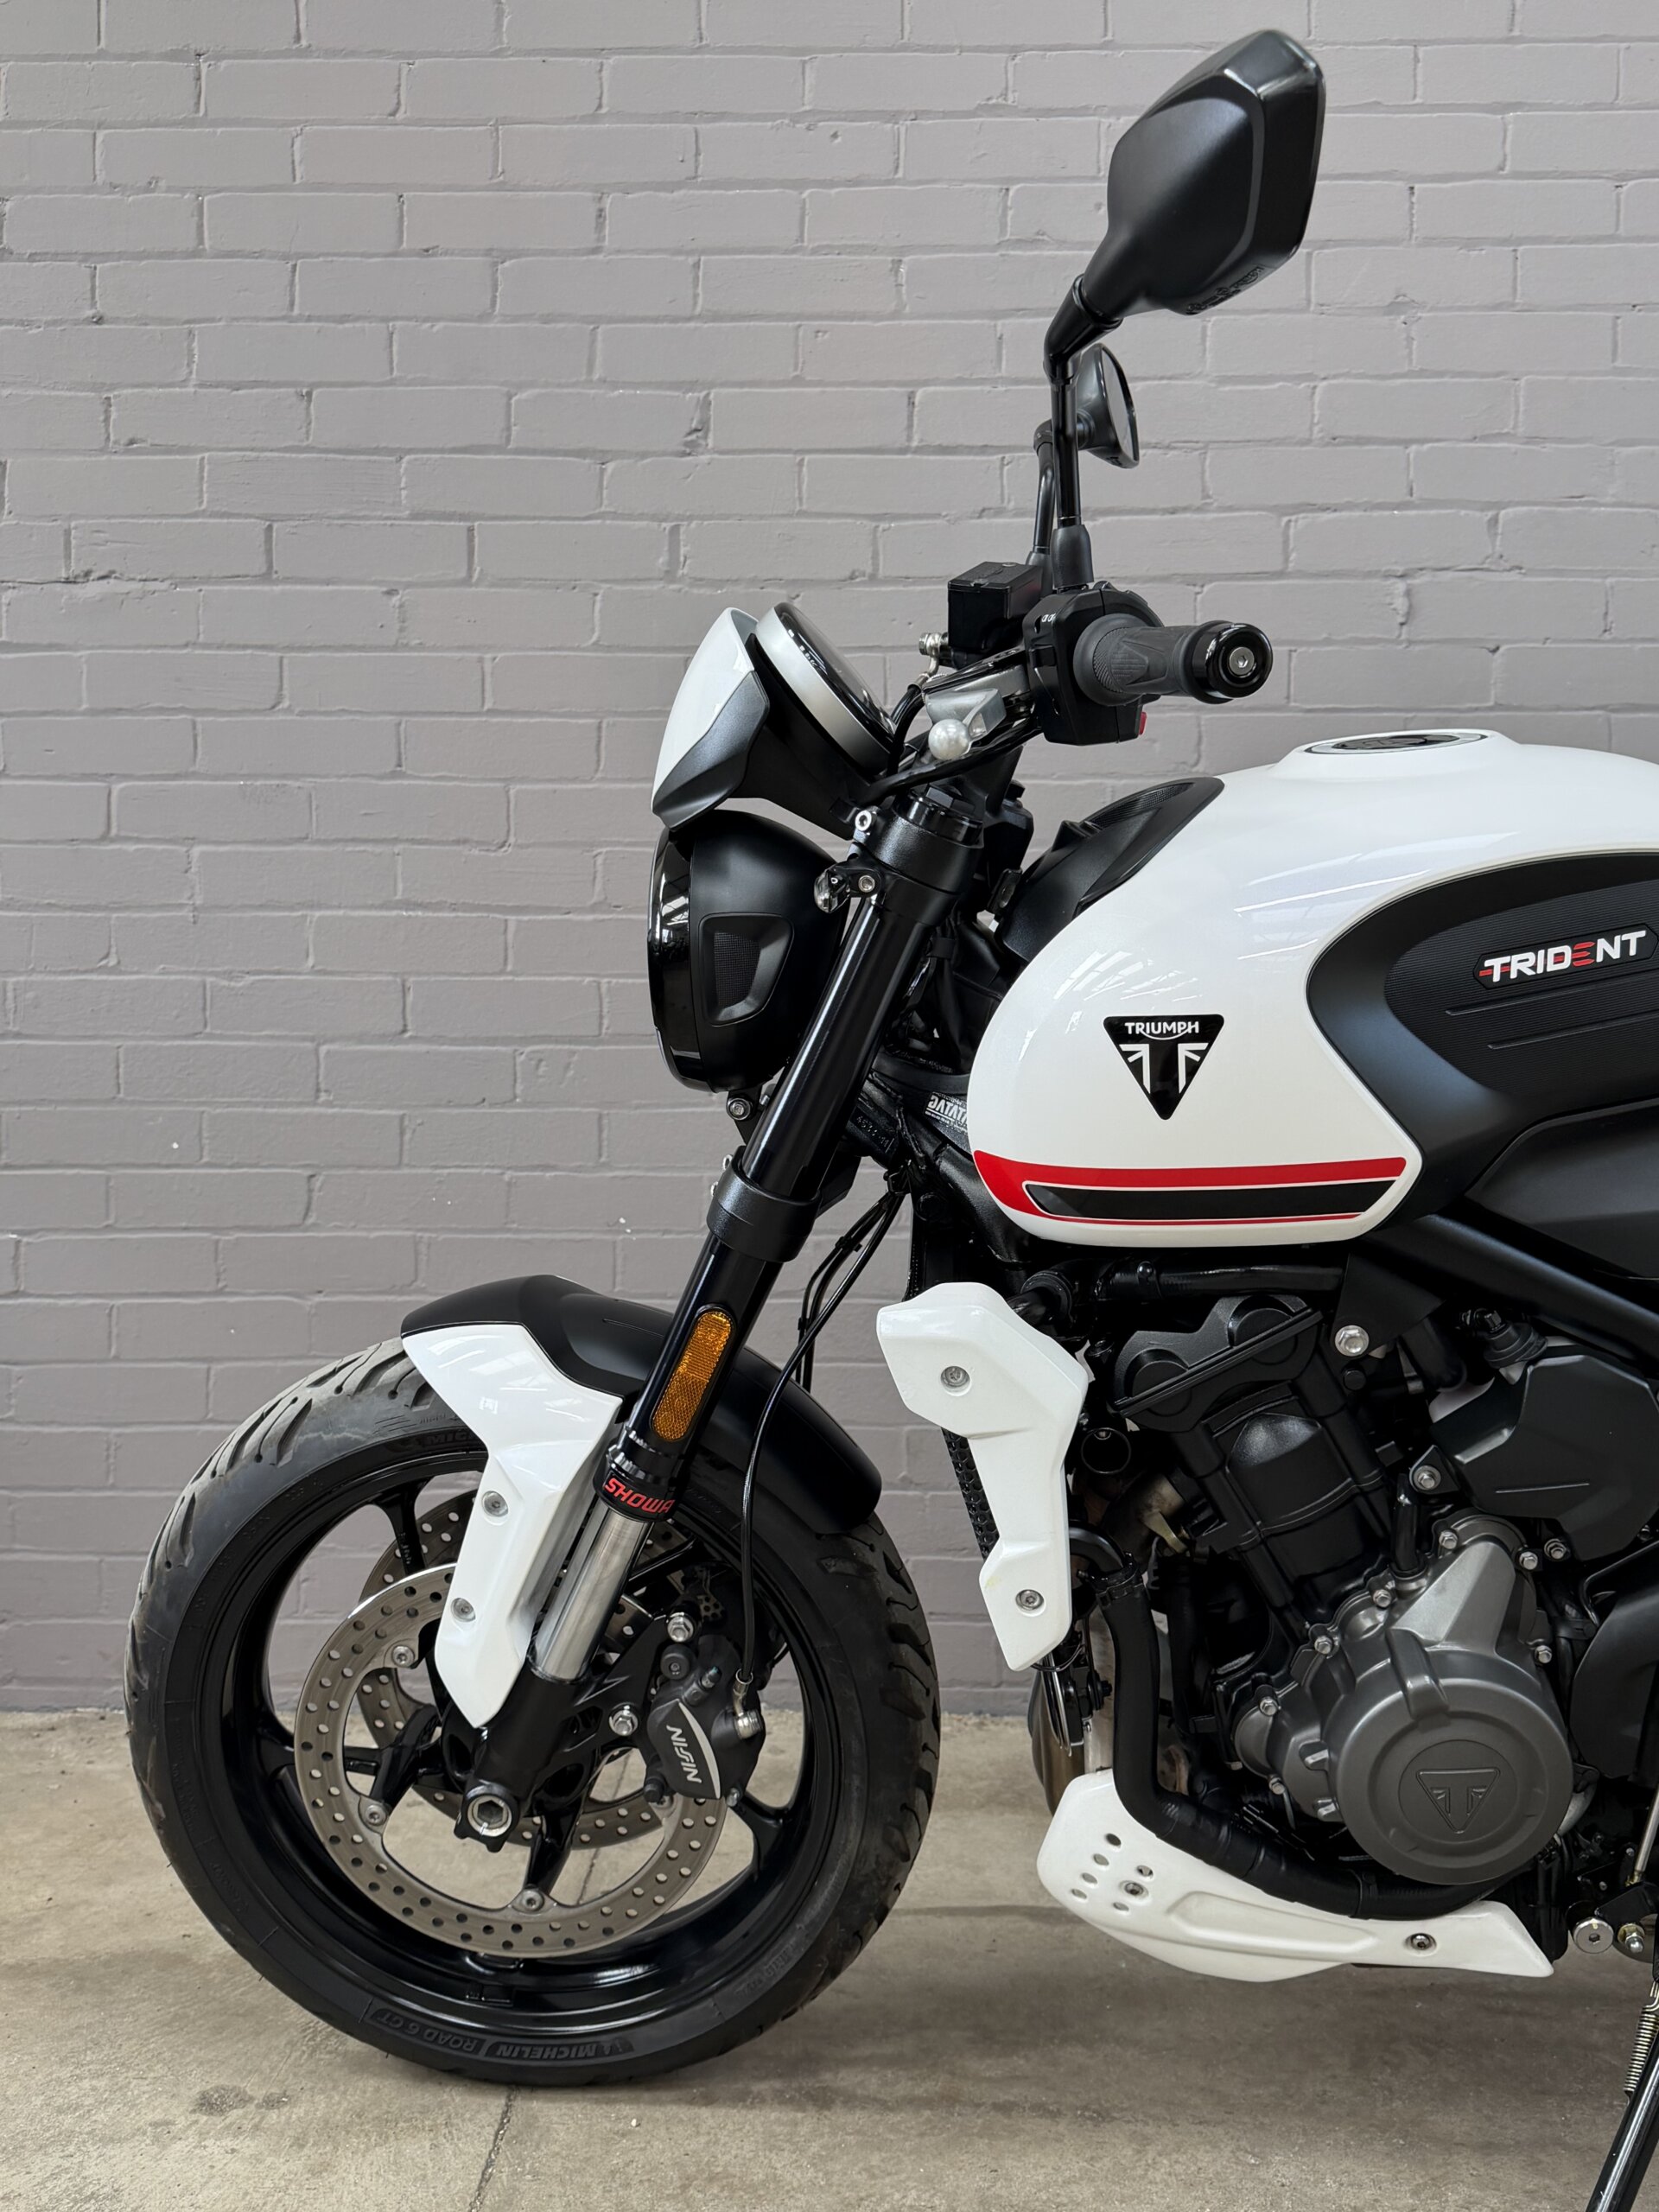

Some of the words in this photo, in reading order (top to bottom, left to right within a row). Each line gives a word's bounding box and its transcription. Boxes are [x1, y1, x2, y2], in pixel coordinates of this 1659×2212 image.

[1483, 930, 1646, 982] TRIDENT
[1124, 1021, 1199, 1039] TRIUMPH
[605, 1478, 675, 1514] SHOWA
[424, 2027, 478, 2051] ROAD
[495, 2043, 596, 2060] MICHELIN
